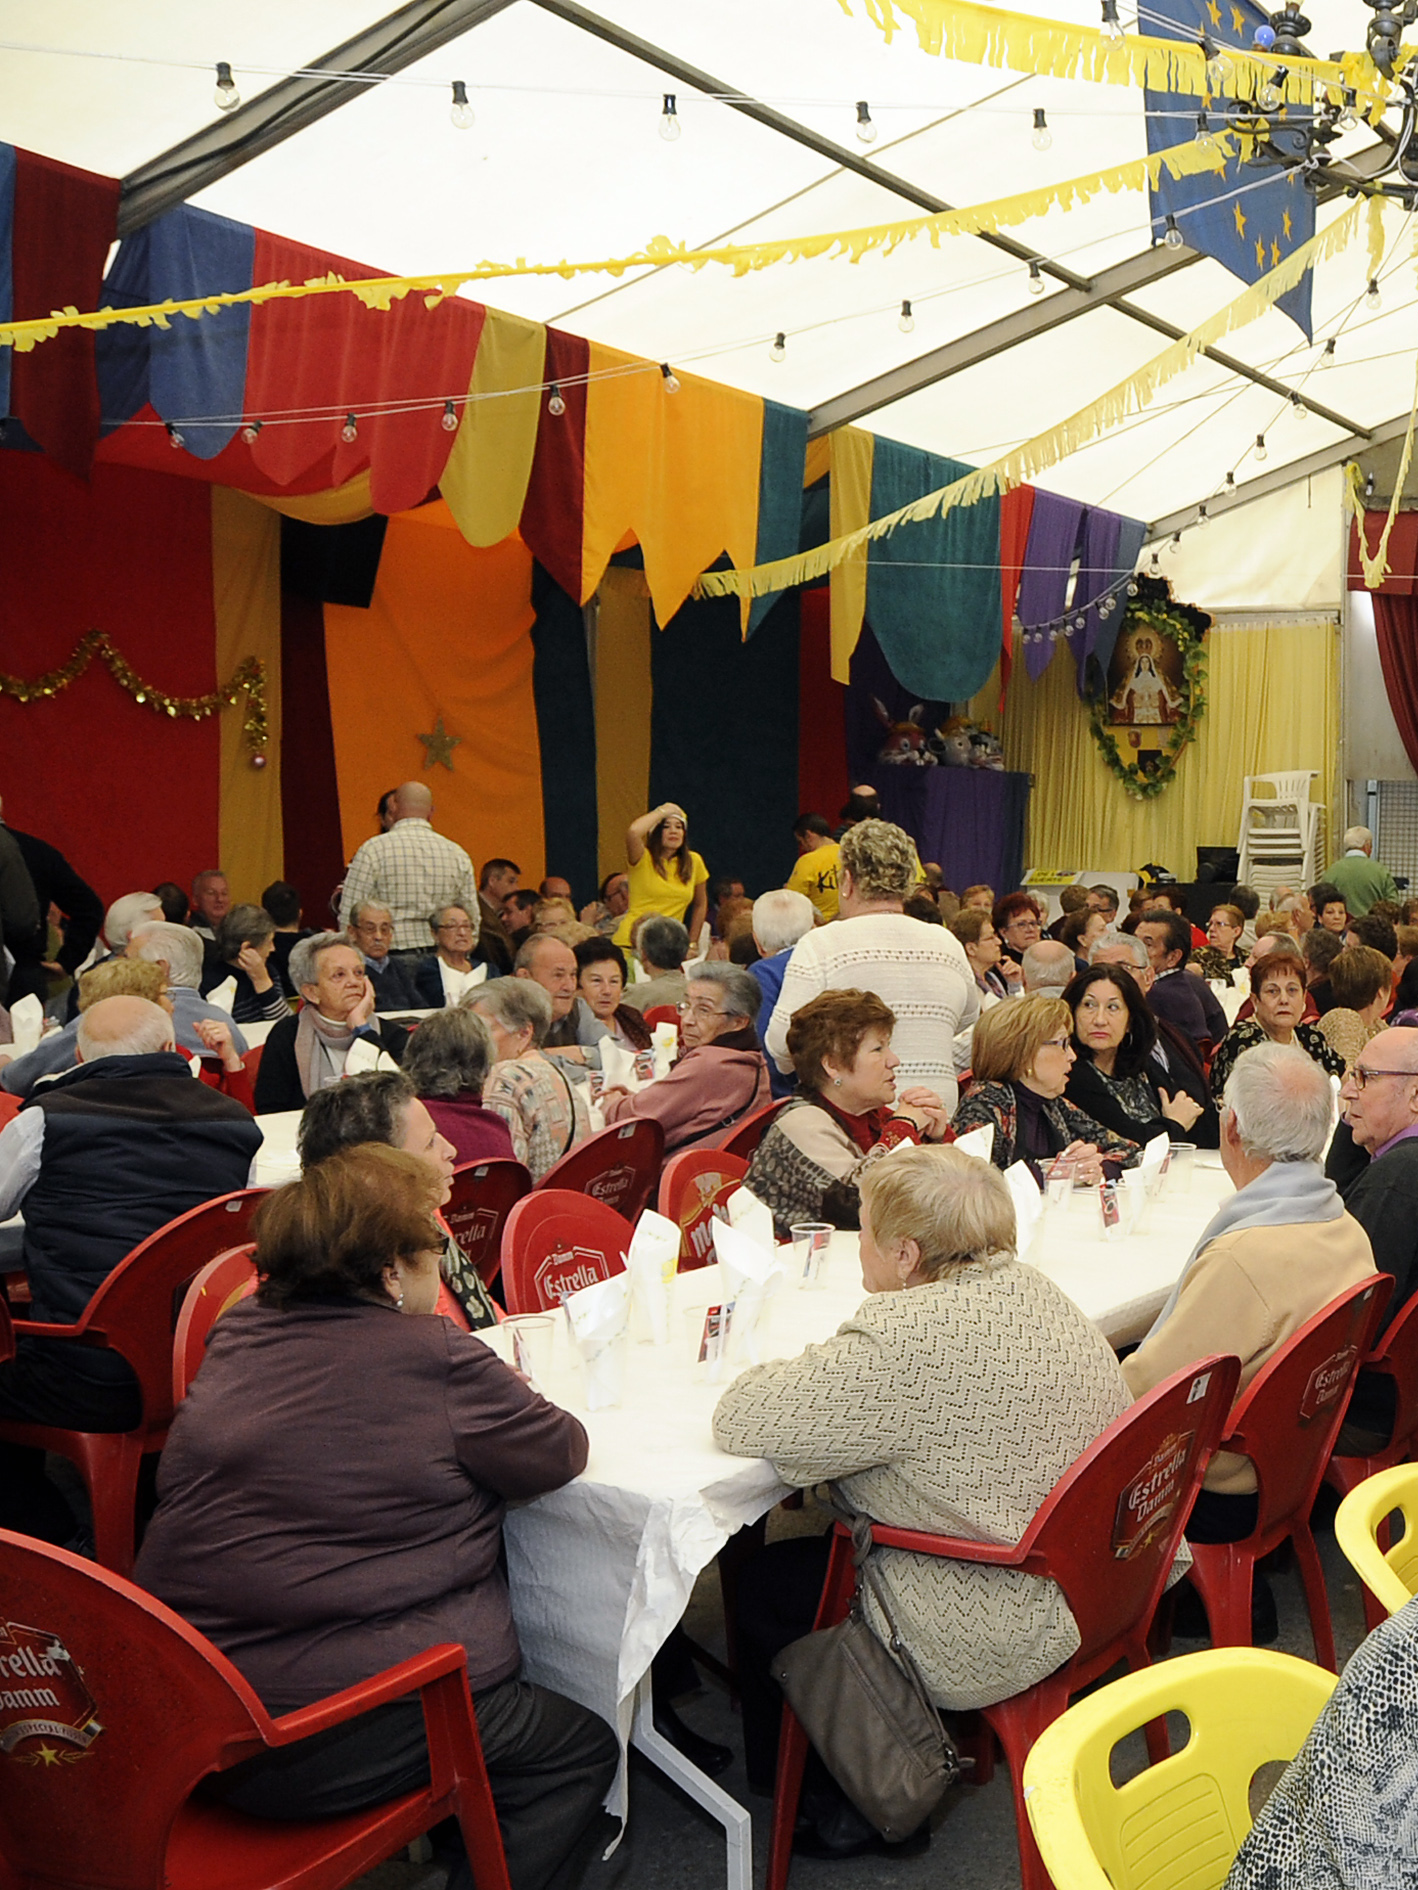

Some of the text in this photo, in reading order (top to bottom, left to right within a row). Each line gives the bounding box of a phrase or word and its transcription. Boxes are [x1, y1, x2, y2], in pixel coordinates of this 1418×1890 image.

[454, 1224, 486, 1246] rella
[544, 1264, 599, 1301] Estrella
[1128, 1448, 1187, 1511] Estrella
[1136, 1478, 1175, 1523] Damm
[0, 1645, 62, 1679] rella
